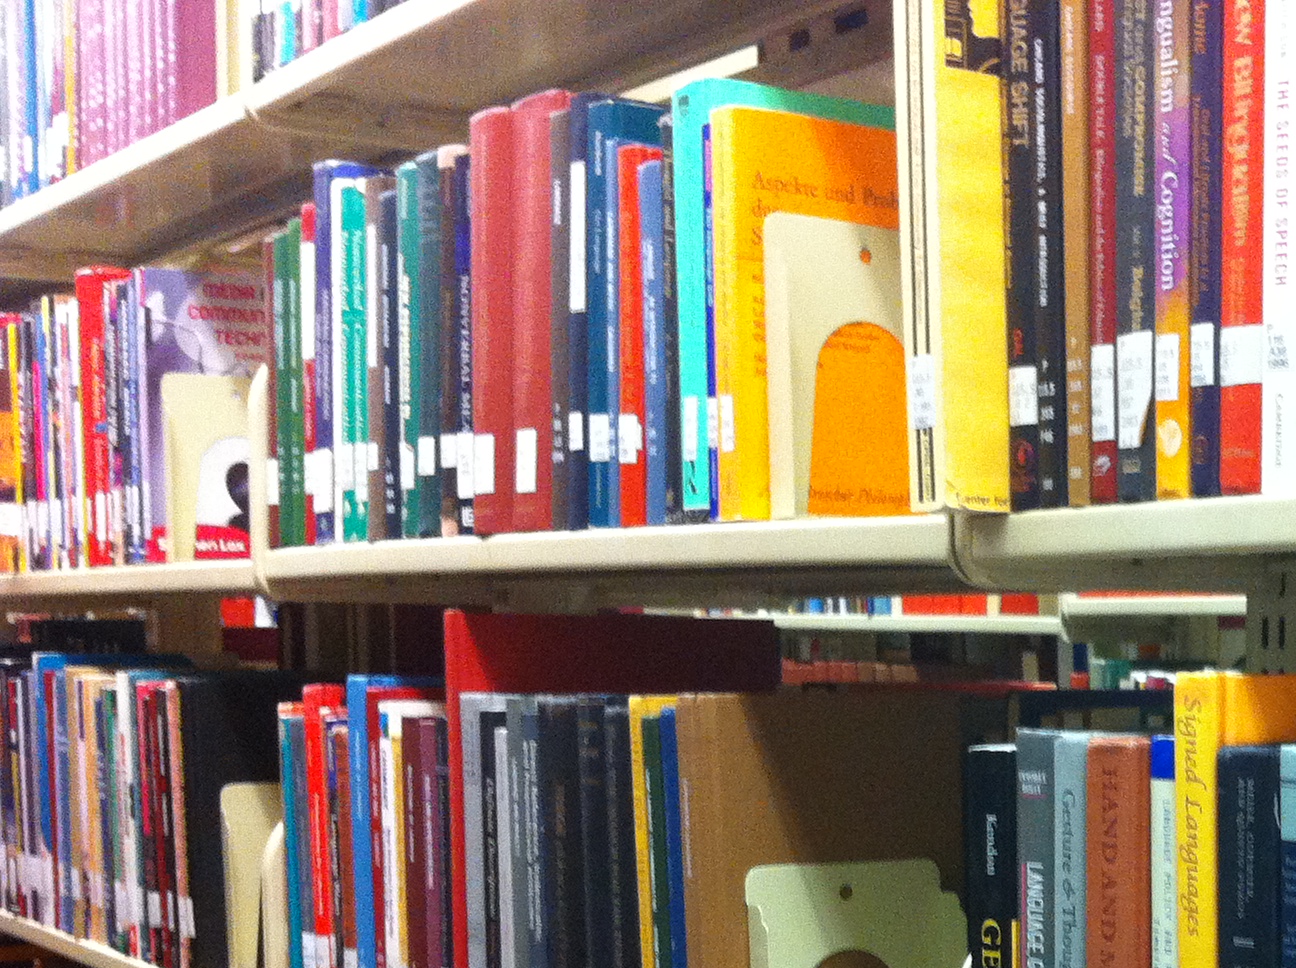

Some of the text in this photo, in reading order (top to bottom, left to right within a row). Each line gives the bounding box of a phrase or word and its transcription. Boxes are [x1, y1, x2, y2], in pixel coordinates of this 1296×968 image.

[1011, 82, 1028, 150] SHIFT
[1159, 170, 1179, 291] Cognition
[1275, 79, 1289, 286] THE SEEDS OF SPEECH
[1060, 788, 1078, 875] Gesture
[1099, 766, 1119, 865] HAND
[1180, 694, 1208, 937] Signed Languages
[1099, 869, 1118, 945] AND
